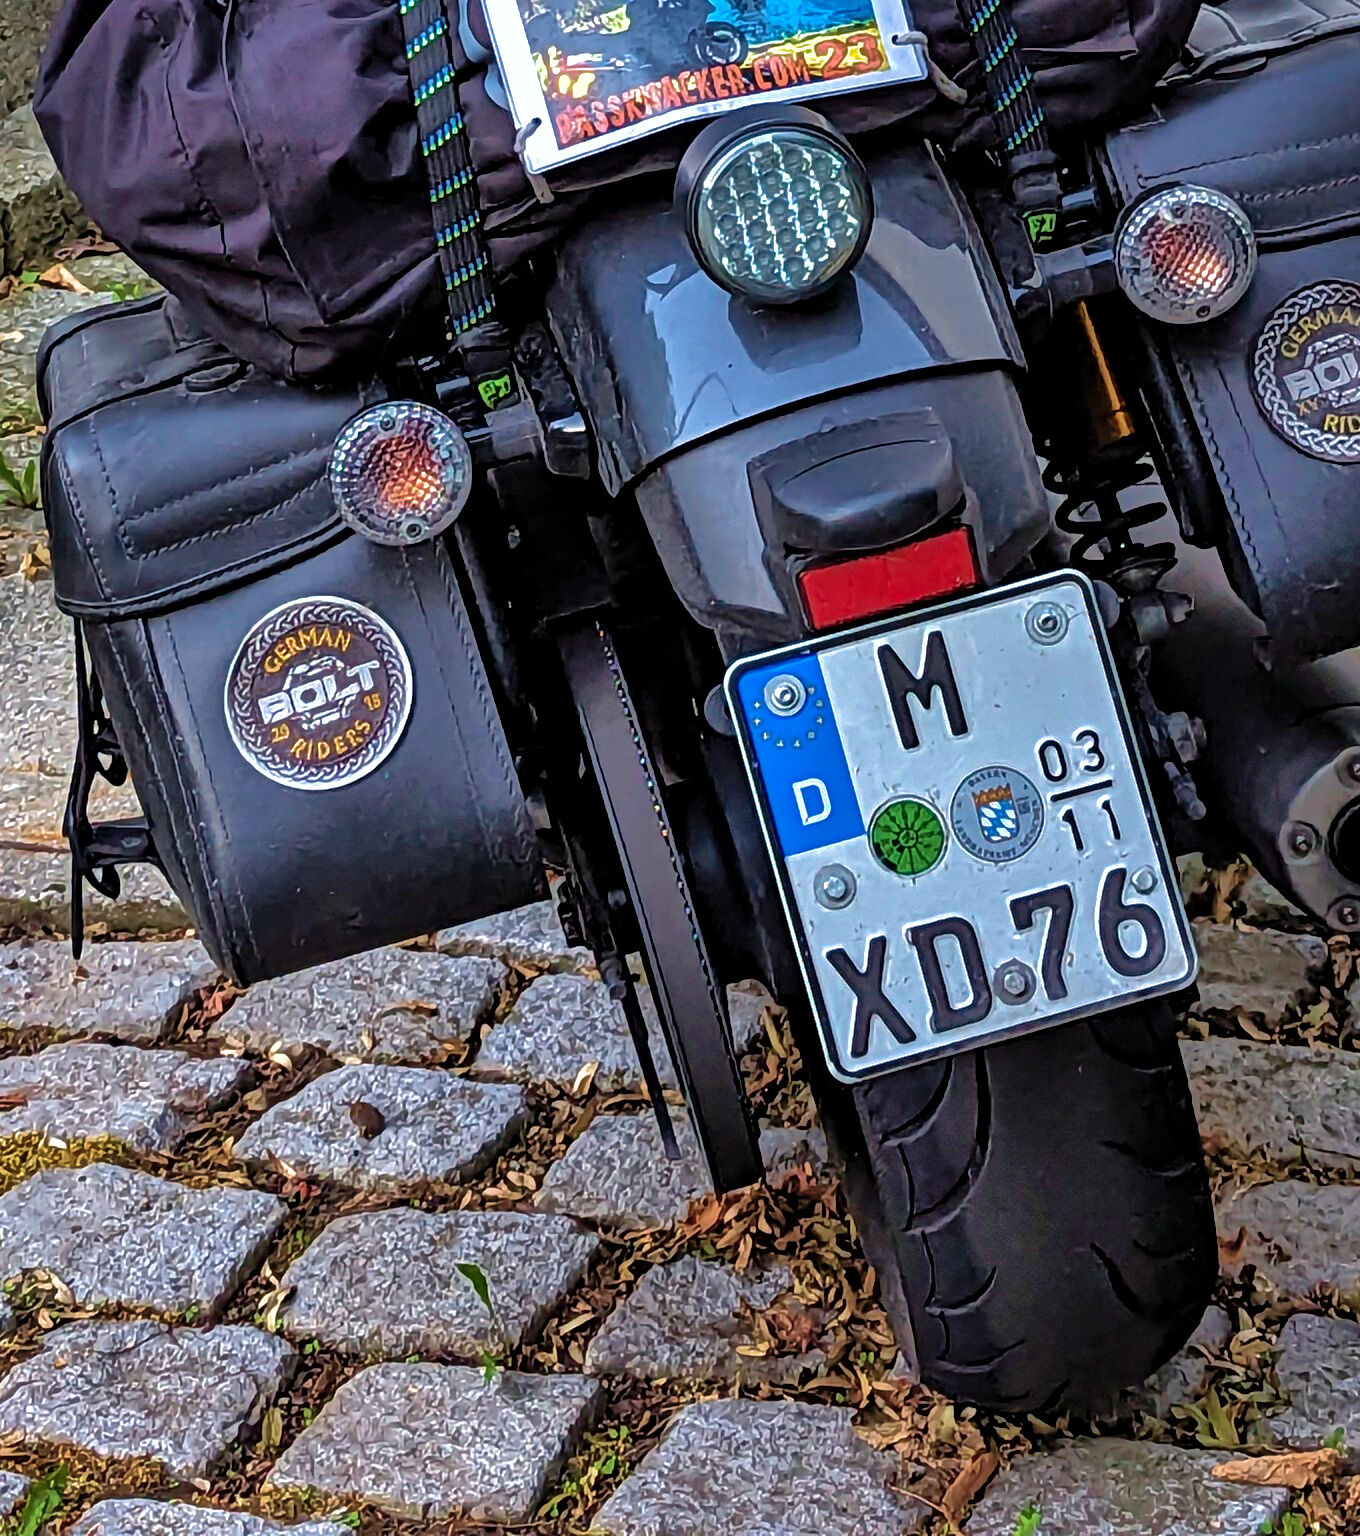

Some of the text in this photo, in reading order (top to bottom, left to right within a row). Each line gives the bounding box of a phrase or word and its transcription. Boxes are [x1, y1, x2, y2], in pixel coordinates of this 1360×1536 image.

[814, 34, 884, 80] 23
[264, 626, 352, 674] GERMAN
[257, 660, 380, 725] BOLT
[876, 630, 969, 750] M
[290, 719, 372, 761] RIDERS
[1037, 729, 1105, 783] 03
[791, 777, 832, 826] D
[1059, 798, 1122, 852] 11
[825, 867, 1166, 1059] XD 76
